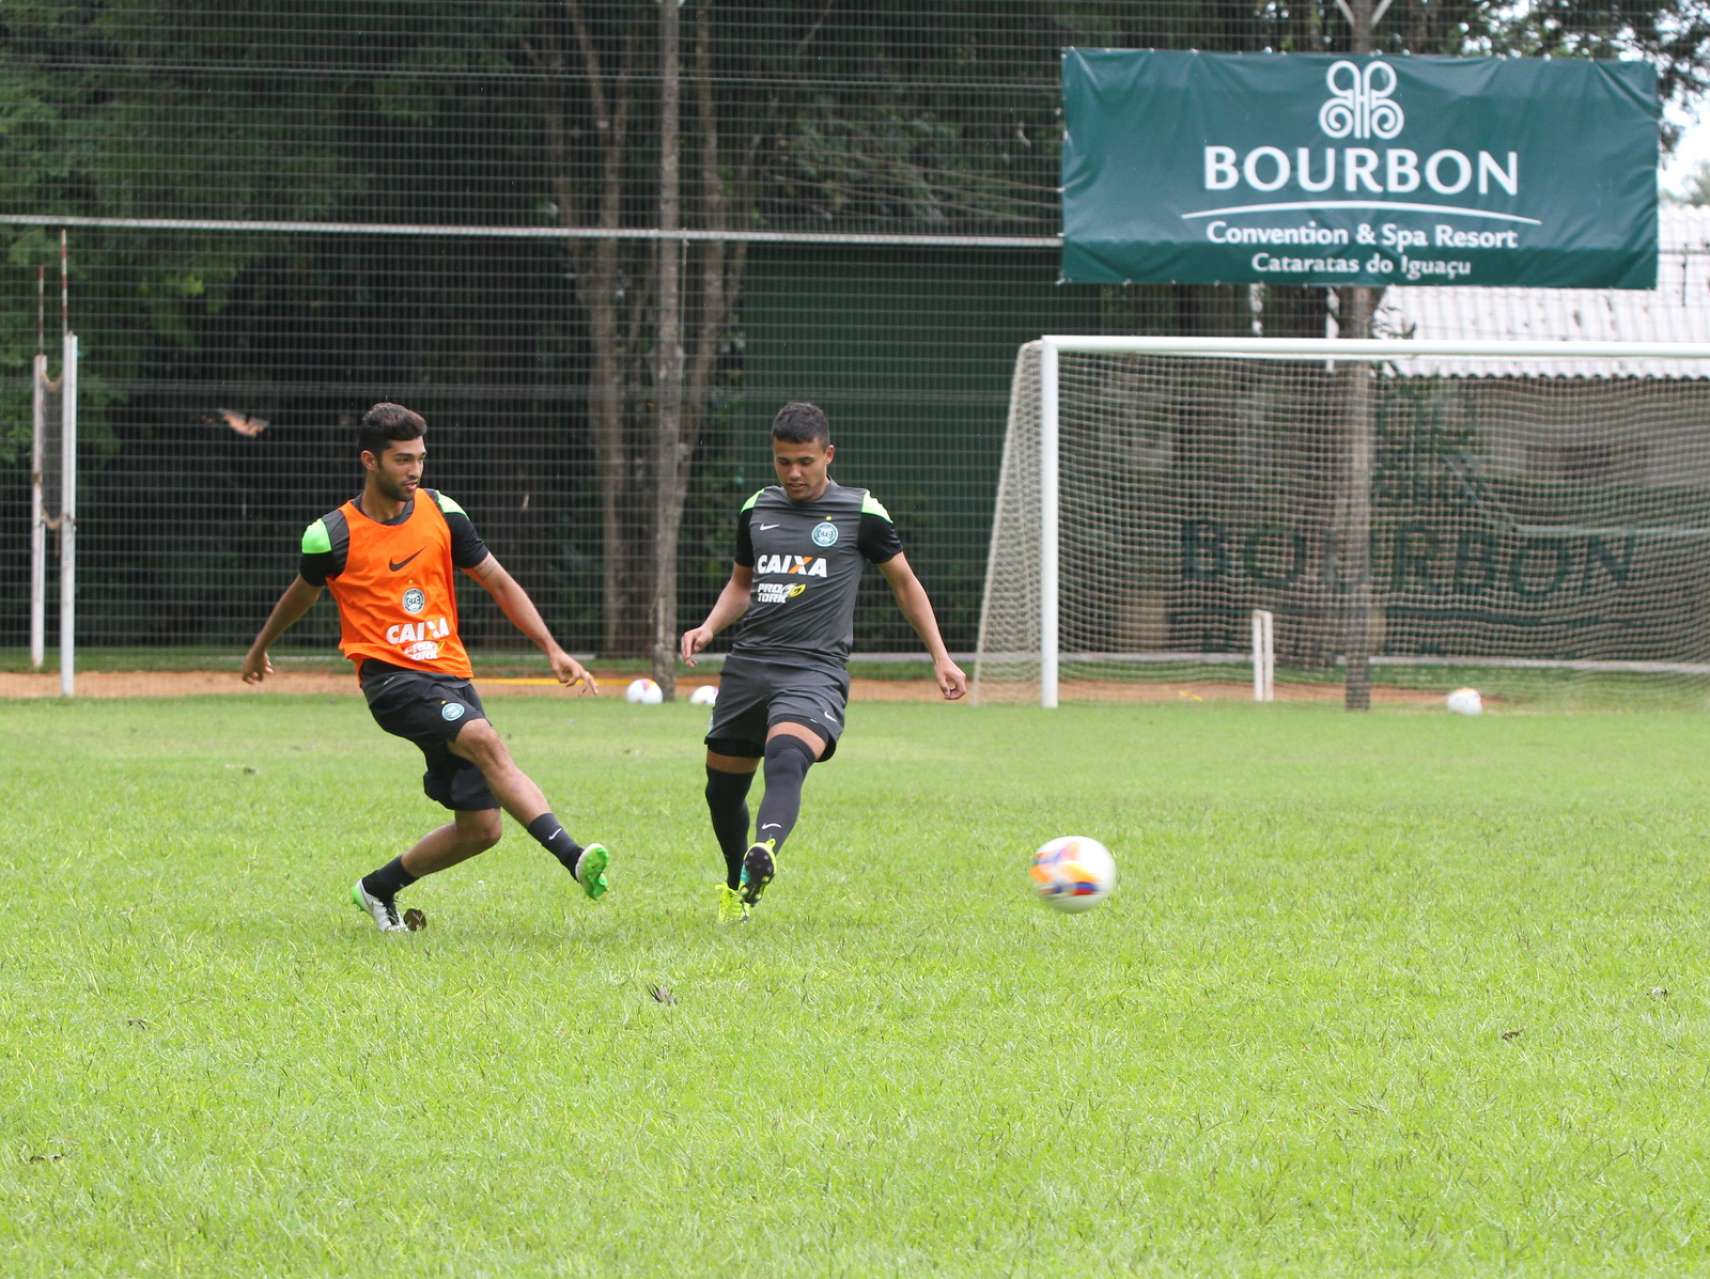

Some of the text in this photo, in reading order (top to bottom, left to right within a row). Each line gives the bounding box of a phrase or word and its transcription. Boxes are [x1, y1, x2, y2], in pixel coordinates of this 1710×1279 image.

[1203, 145, 1519, 196] BOURBON
[1207, 220, 1518, 253] Convention & Spa Resort
[1251, 252, 1471, 281] Cataratas do Iguaçu
[757, 554, 827, 577] CAIXA
[386, 617, 451, 645] CAIXA
